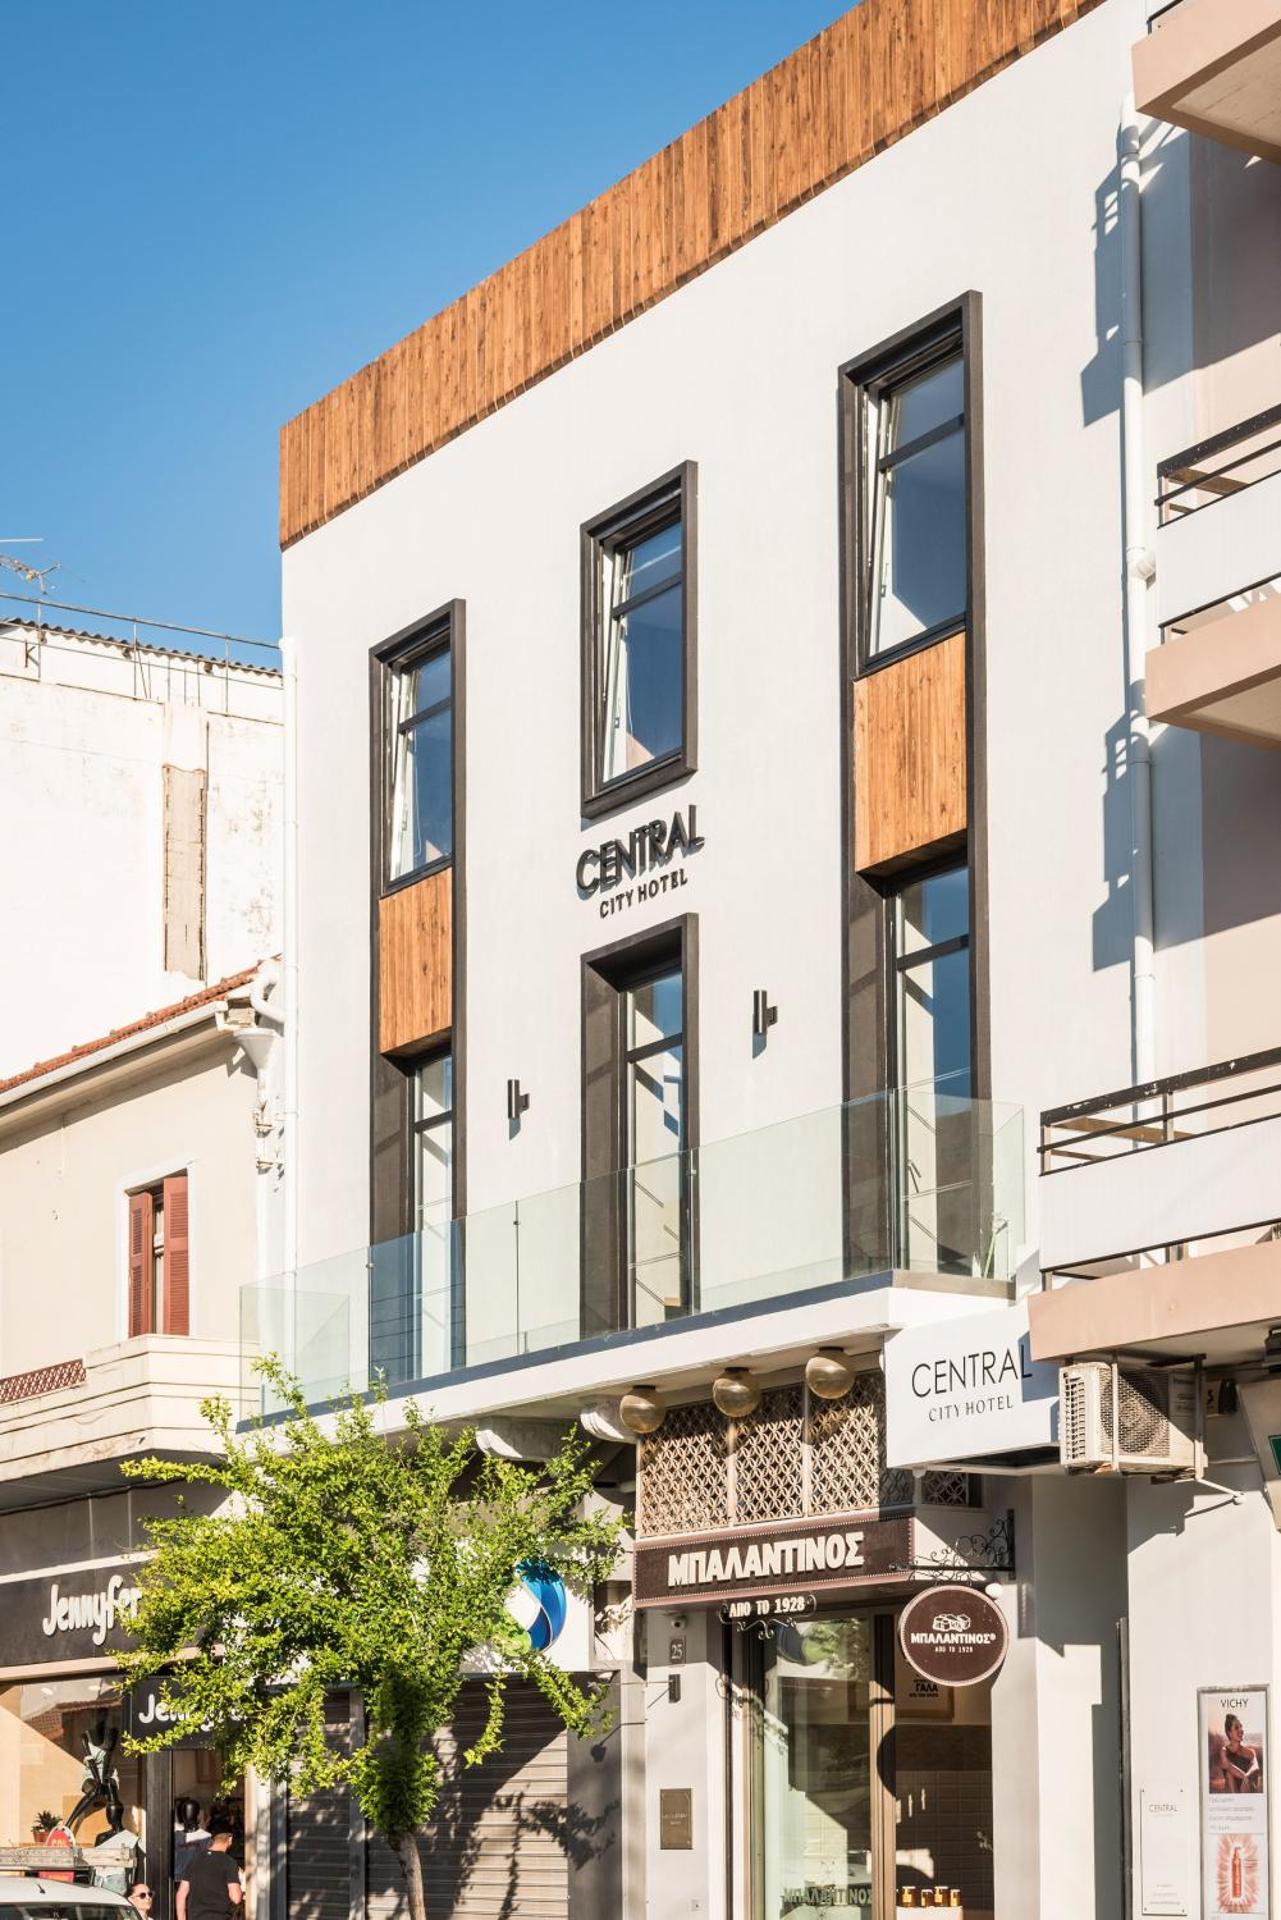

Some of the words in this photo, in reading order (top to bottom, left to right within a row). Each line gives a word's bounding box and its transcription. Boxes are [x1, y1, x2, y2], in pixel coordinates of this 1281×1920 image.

[576, 804, 705, 896] CENTRAL
[599, 889, 634, 919] CITY
[637, 867, 689, 904] HOTEL
[911, 1344, 1033, 1398] CENTRAL
[928, 1404, 960, 1422] CITY
[965, 1395, 1014, 1416] HOTEL
[667, 1531, 865, 1587] ΜΠΑΛΑΝΤΙΝΟΣ
[774, 1597, 805, 1614] 1928
[671, 1643, 683, 1660] 25
[1220, 1698, 1249, 1709] VICHY
[1149, 1803, 1178, 1812] CENTRAL
